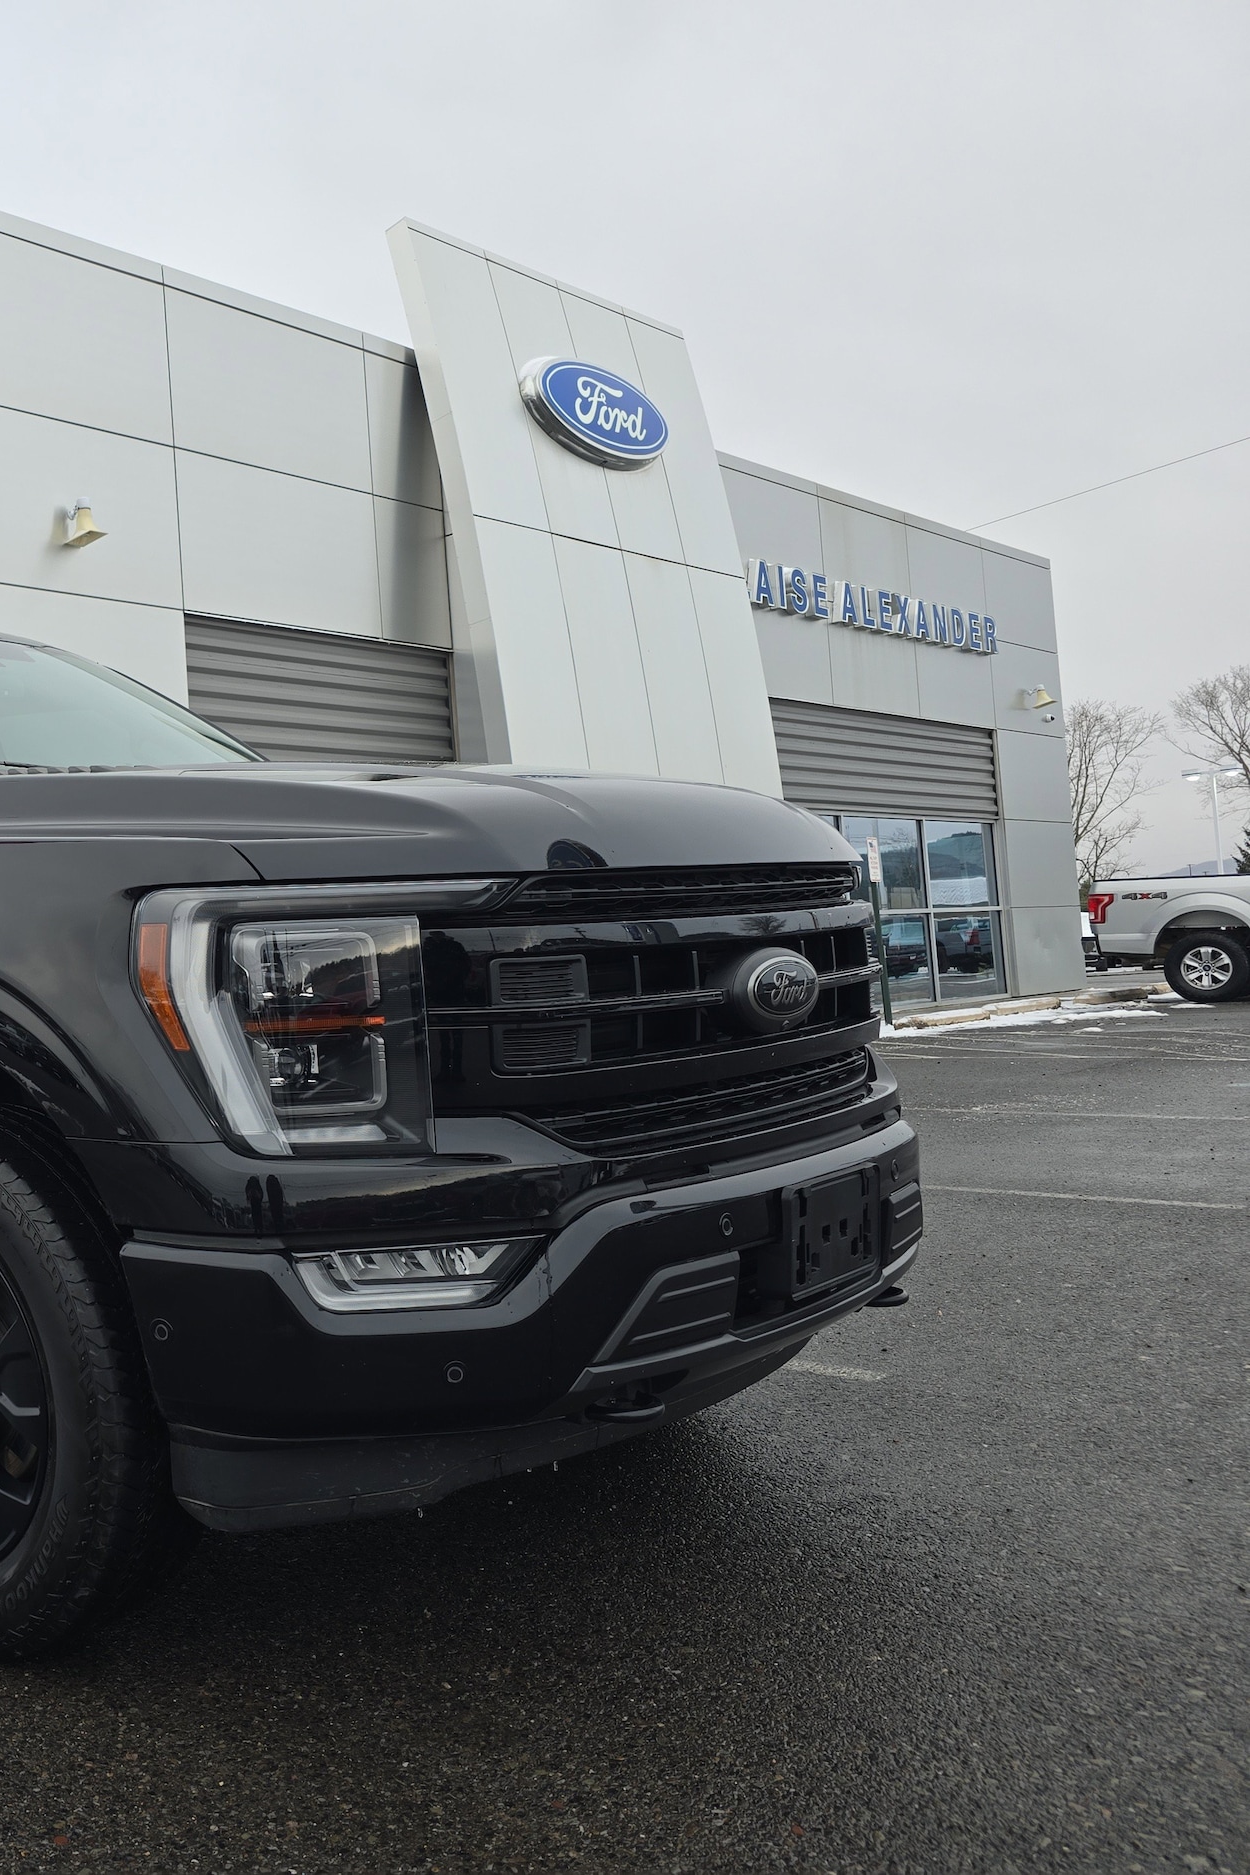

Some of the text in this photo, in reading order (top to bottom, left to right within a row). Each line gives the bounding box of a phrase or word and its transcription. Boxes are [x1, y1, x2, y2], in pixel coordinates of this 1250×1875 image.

[575, 376, 647, 441] Ford
[748, 558, 999, 655] AISE ALEXANDER
[771, 970, 808, 1006] Ford
